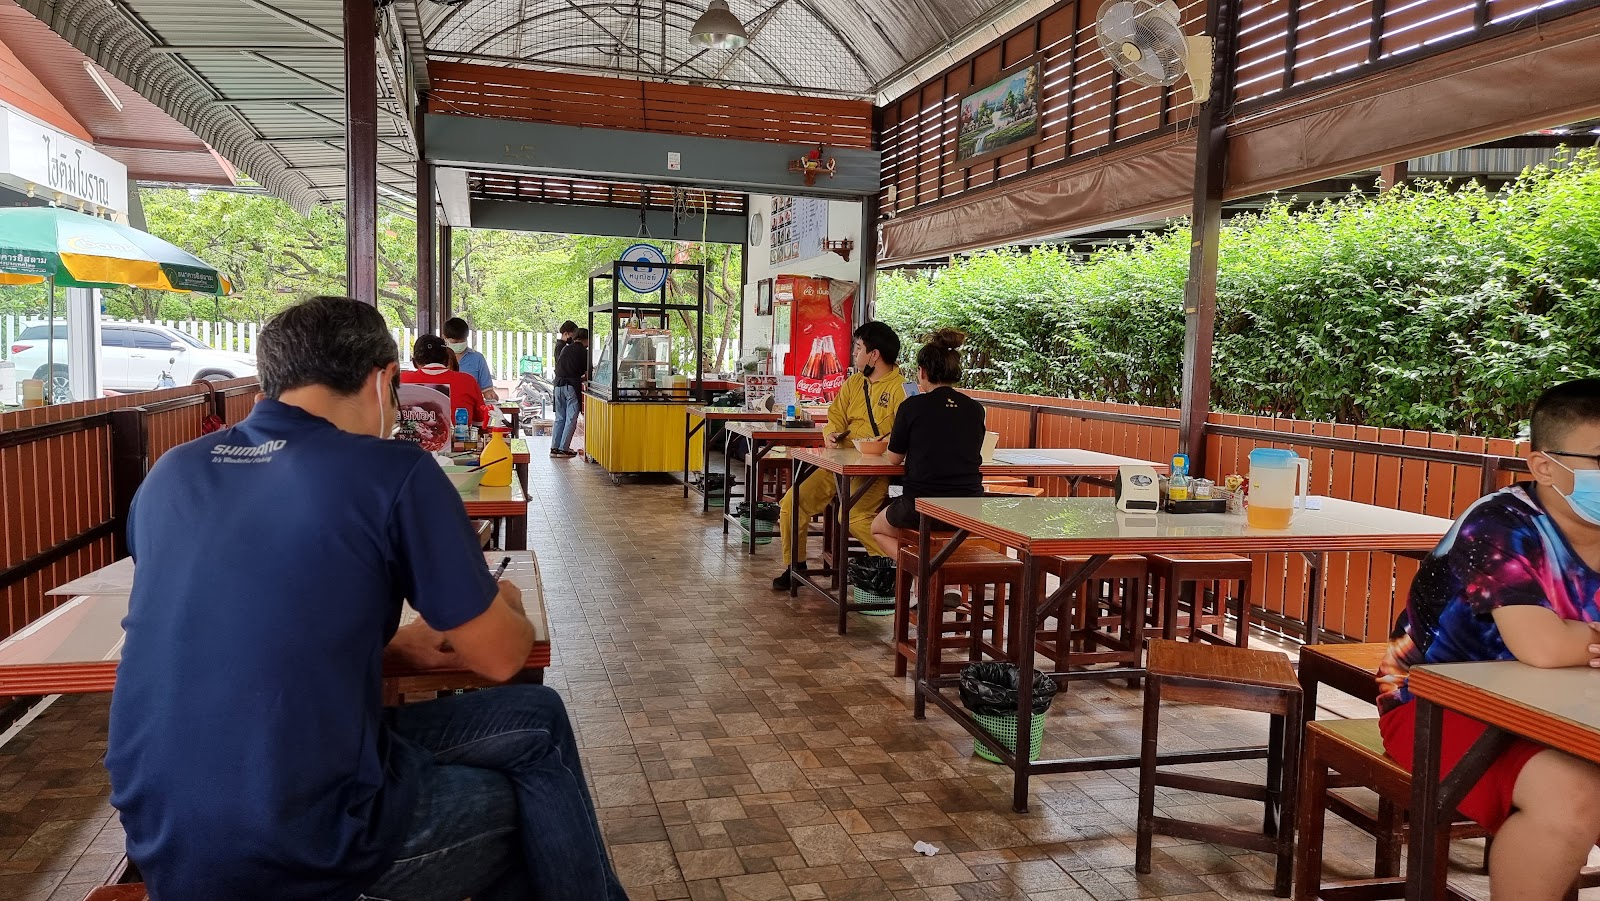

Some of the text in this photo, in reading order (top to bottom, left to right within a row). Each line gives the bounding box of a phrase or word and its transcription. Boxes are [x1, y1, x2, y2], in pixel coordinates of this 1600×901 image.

[42, 133, 109, 206] ไอติมโบราณ
[0, 253, 47, 264] คารอิสลาม
[211, 440, 287, 456] SHIMANO
